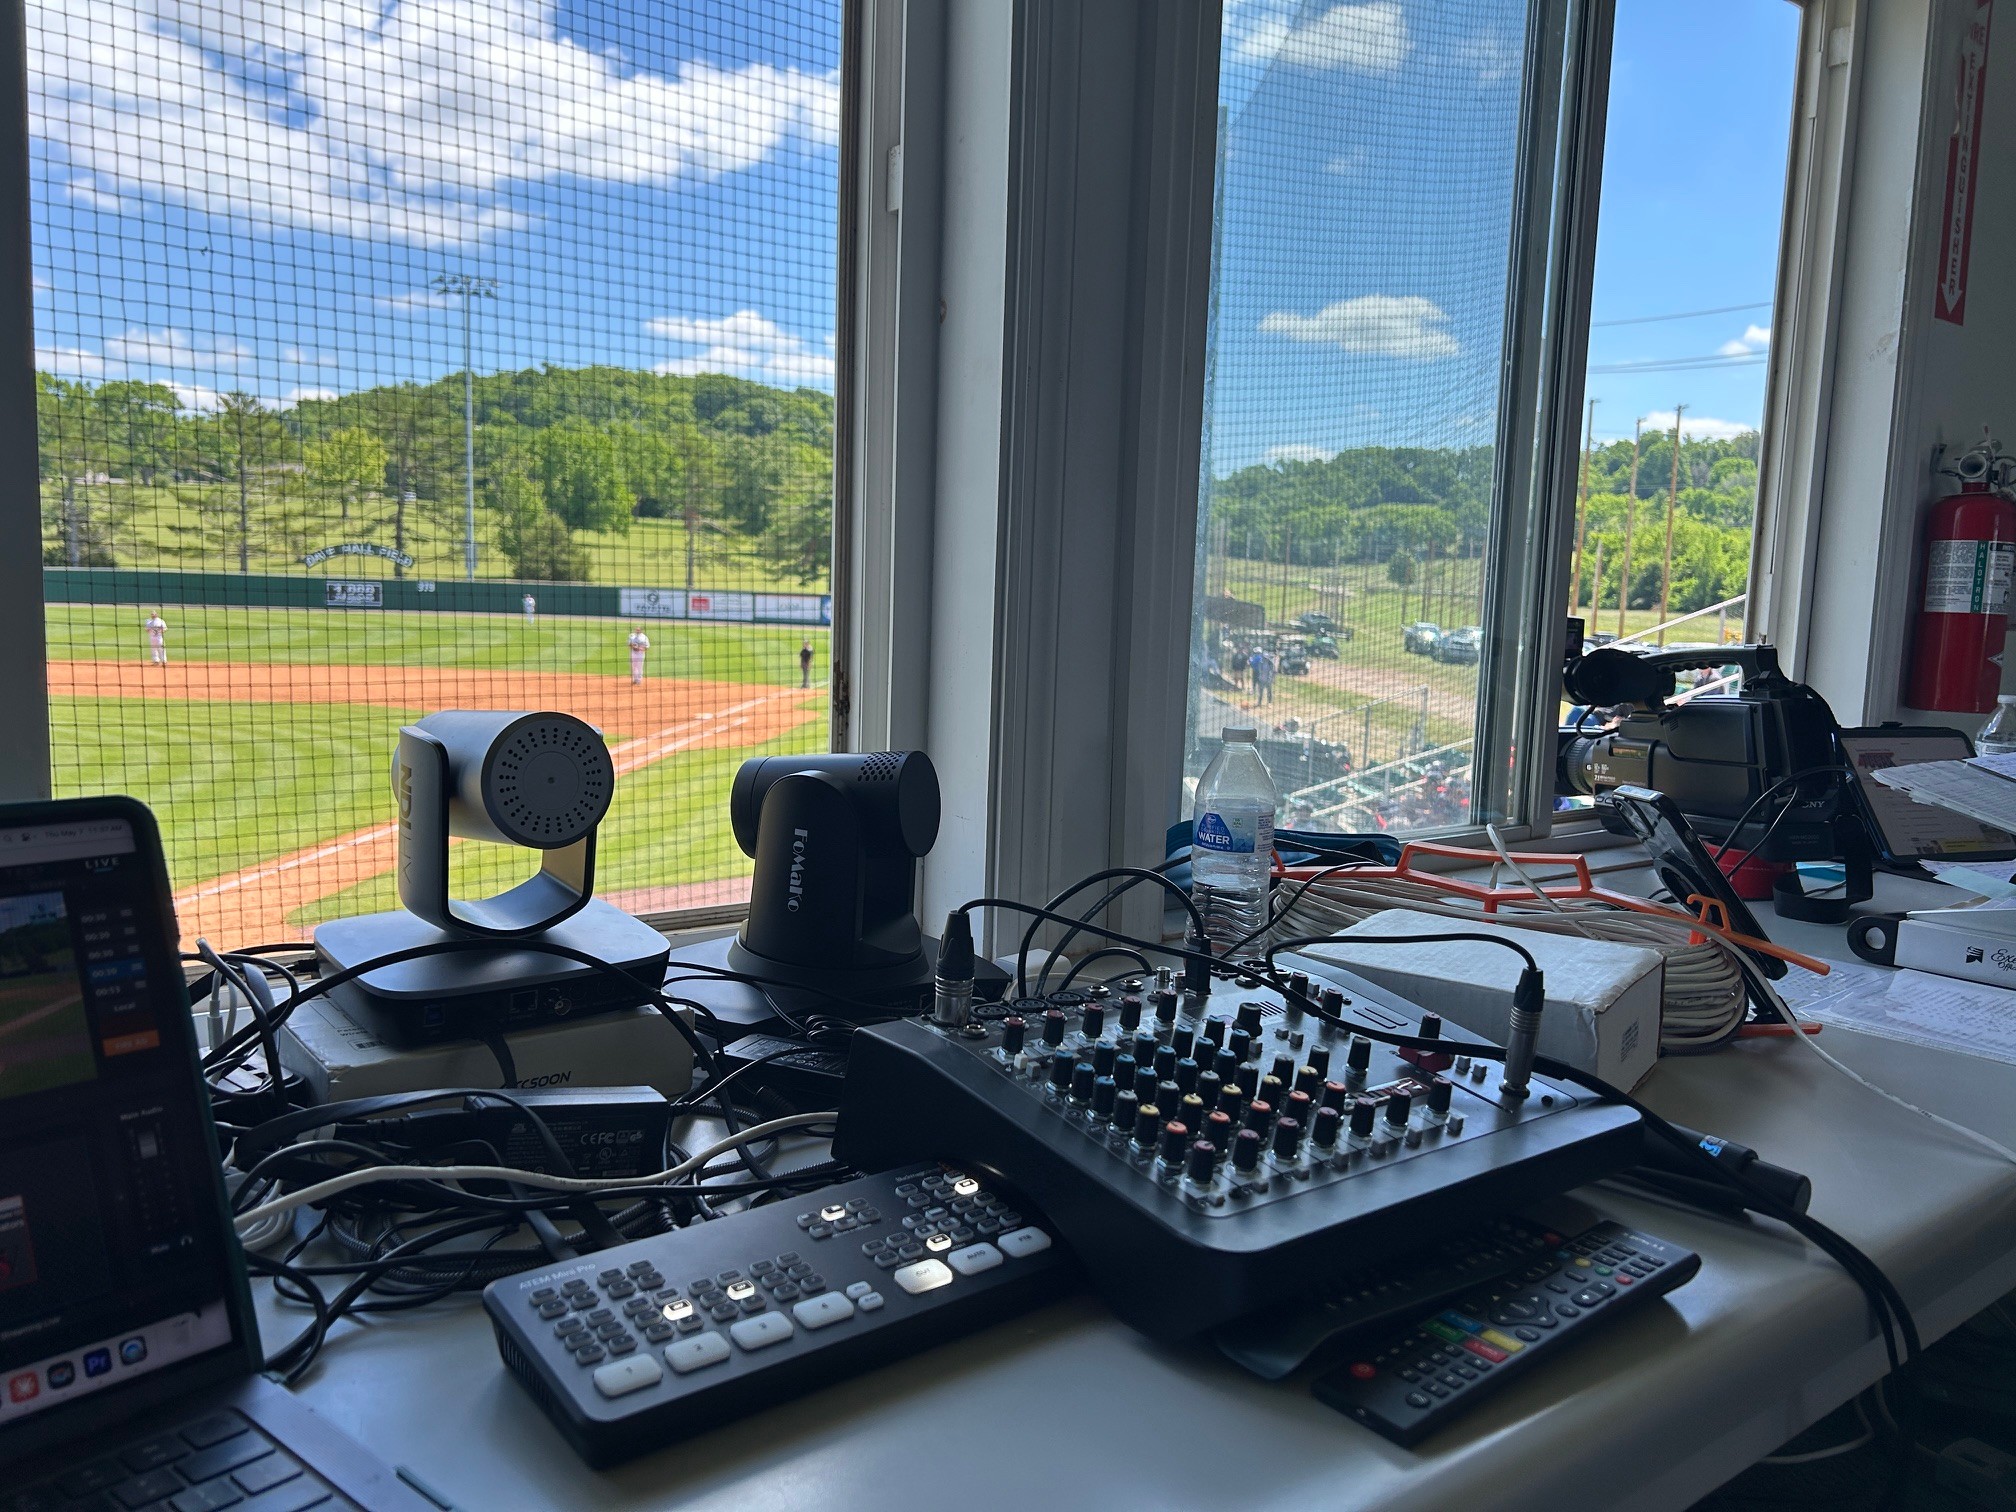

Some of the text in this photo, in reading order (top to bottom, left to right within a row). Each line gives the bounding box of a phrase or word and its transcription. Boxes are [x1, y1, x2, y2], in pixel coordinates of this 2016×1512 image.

[342, 544, 374, 555] HALL
[379, 546, 414, 568] FIELD
[1973, 542, 1986, 611] HALOTRON
[400, 763, 411, 830] NDI
[1198, 831, 1230, 845] WATER
[84, 857, 120, 869] LIVE
[520, 1275, 550, 1290] ATEM
[576, 1263, 596, 1274] Pro
